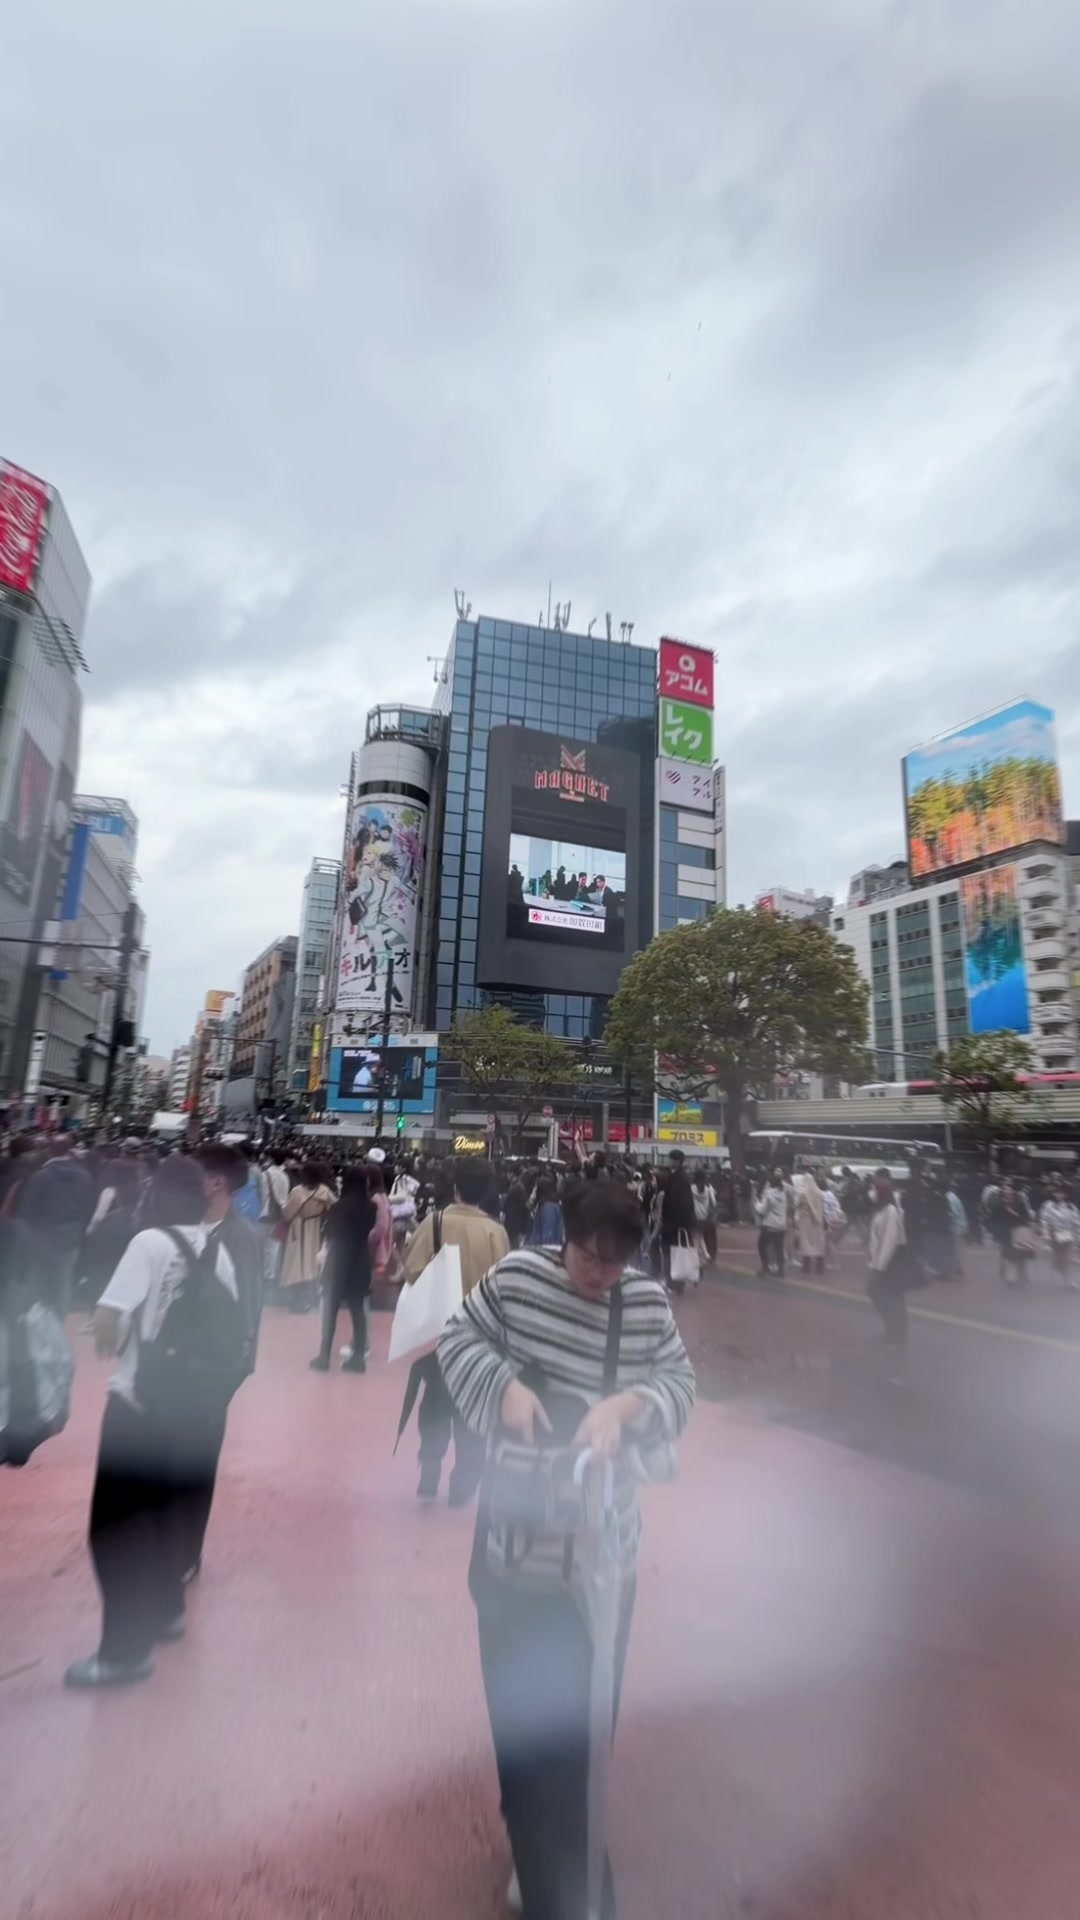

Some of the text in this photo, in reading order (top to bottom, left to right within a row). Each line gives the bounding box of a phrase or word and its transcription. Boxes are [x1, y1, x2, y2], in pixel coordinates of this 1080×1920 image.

[665, 669, 709, 696] アコム
[664, 727, 703, 750] イク
[669, 1130, 705, 1145] プロミス
